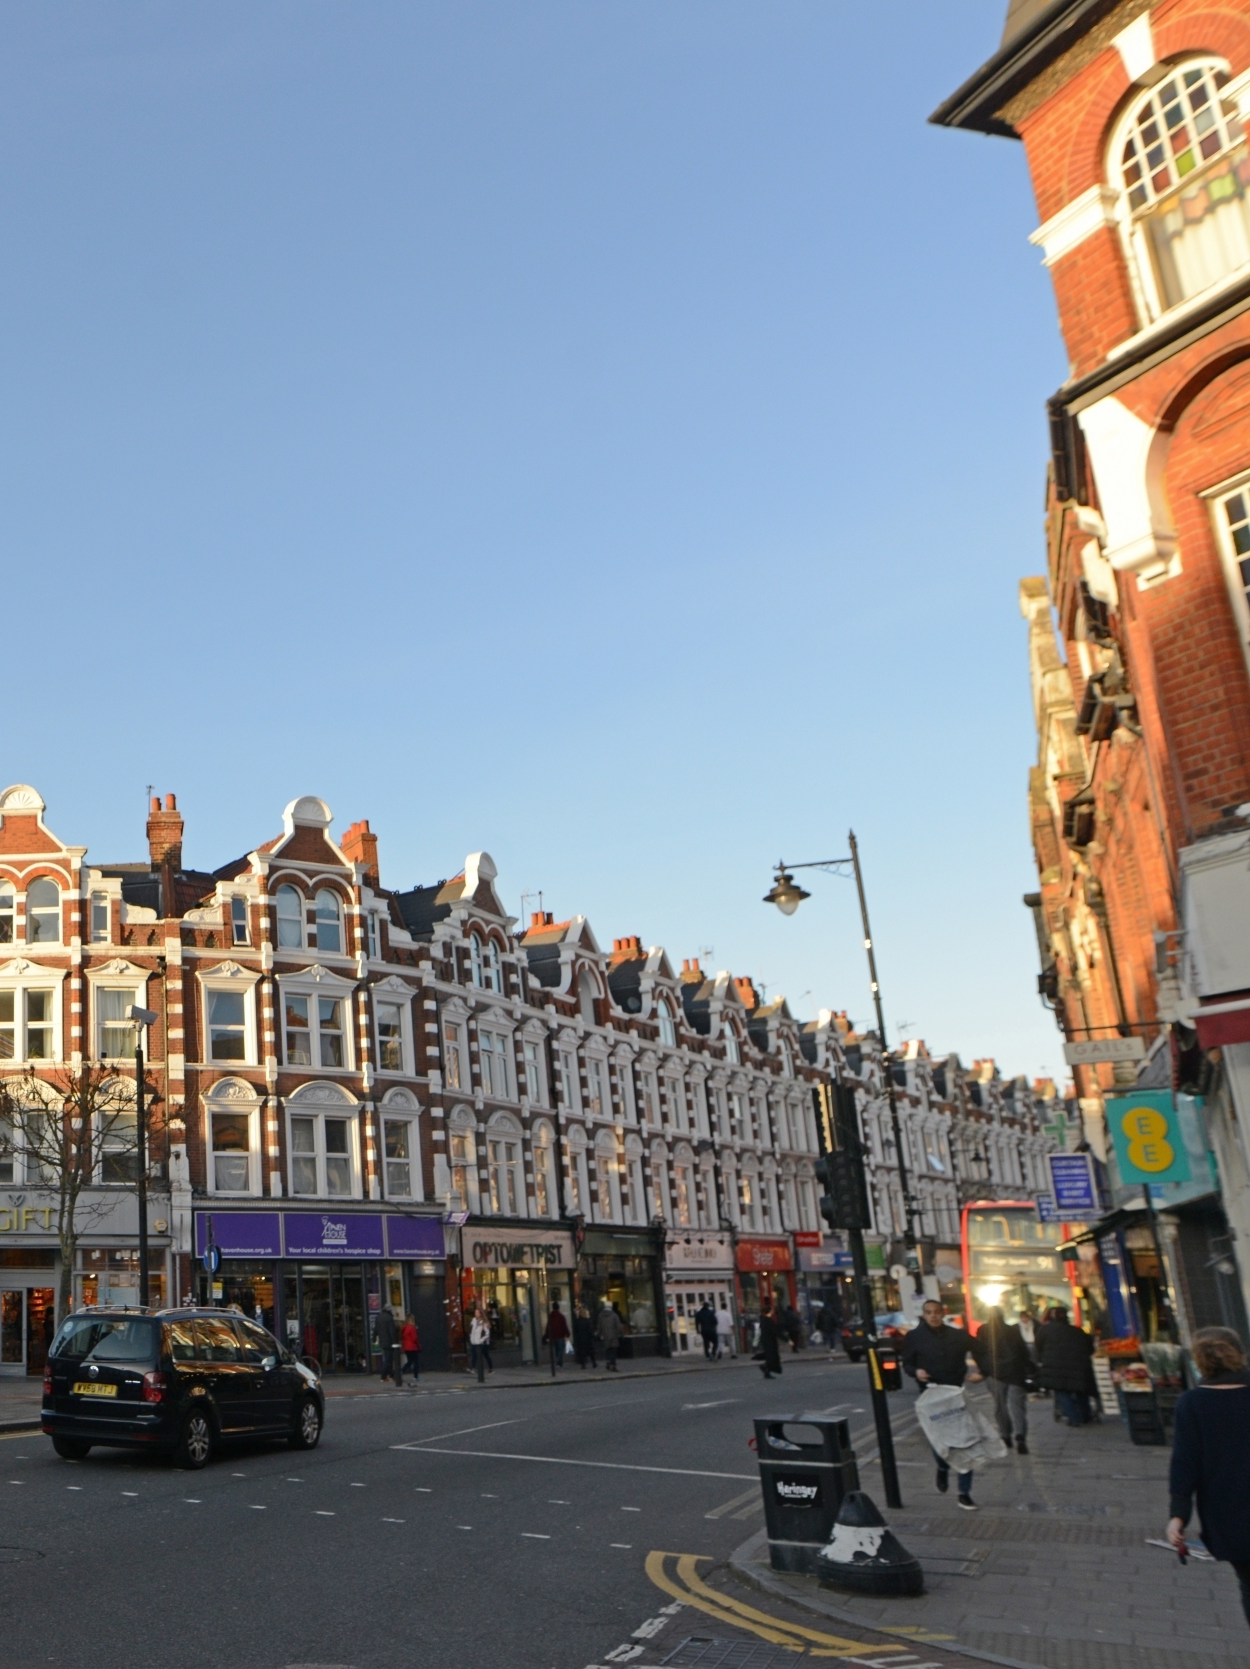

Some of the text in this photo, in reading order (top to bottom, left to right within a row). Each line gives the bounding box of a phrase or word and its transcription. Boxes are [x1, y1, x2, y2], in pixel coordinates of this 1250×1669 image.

[288, 1246, 382, 1256] Your local children's hospice shop
[1036, 1255, 1053, 1270] 91
[776, 1481, 818, 1499] Haringey
